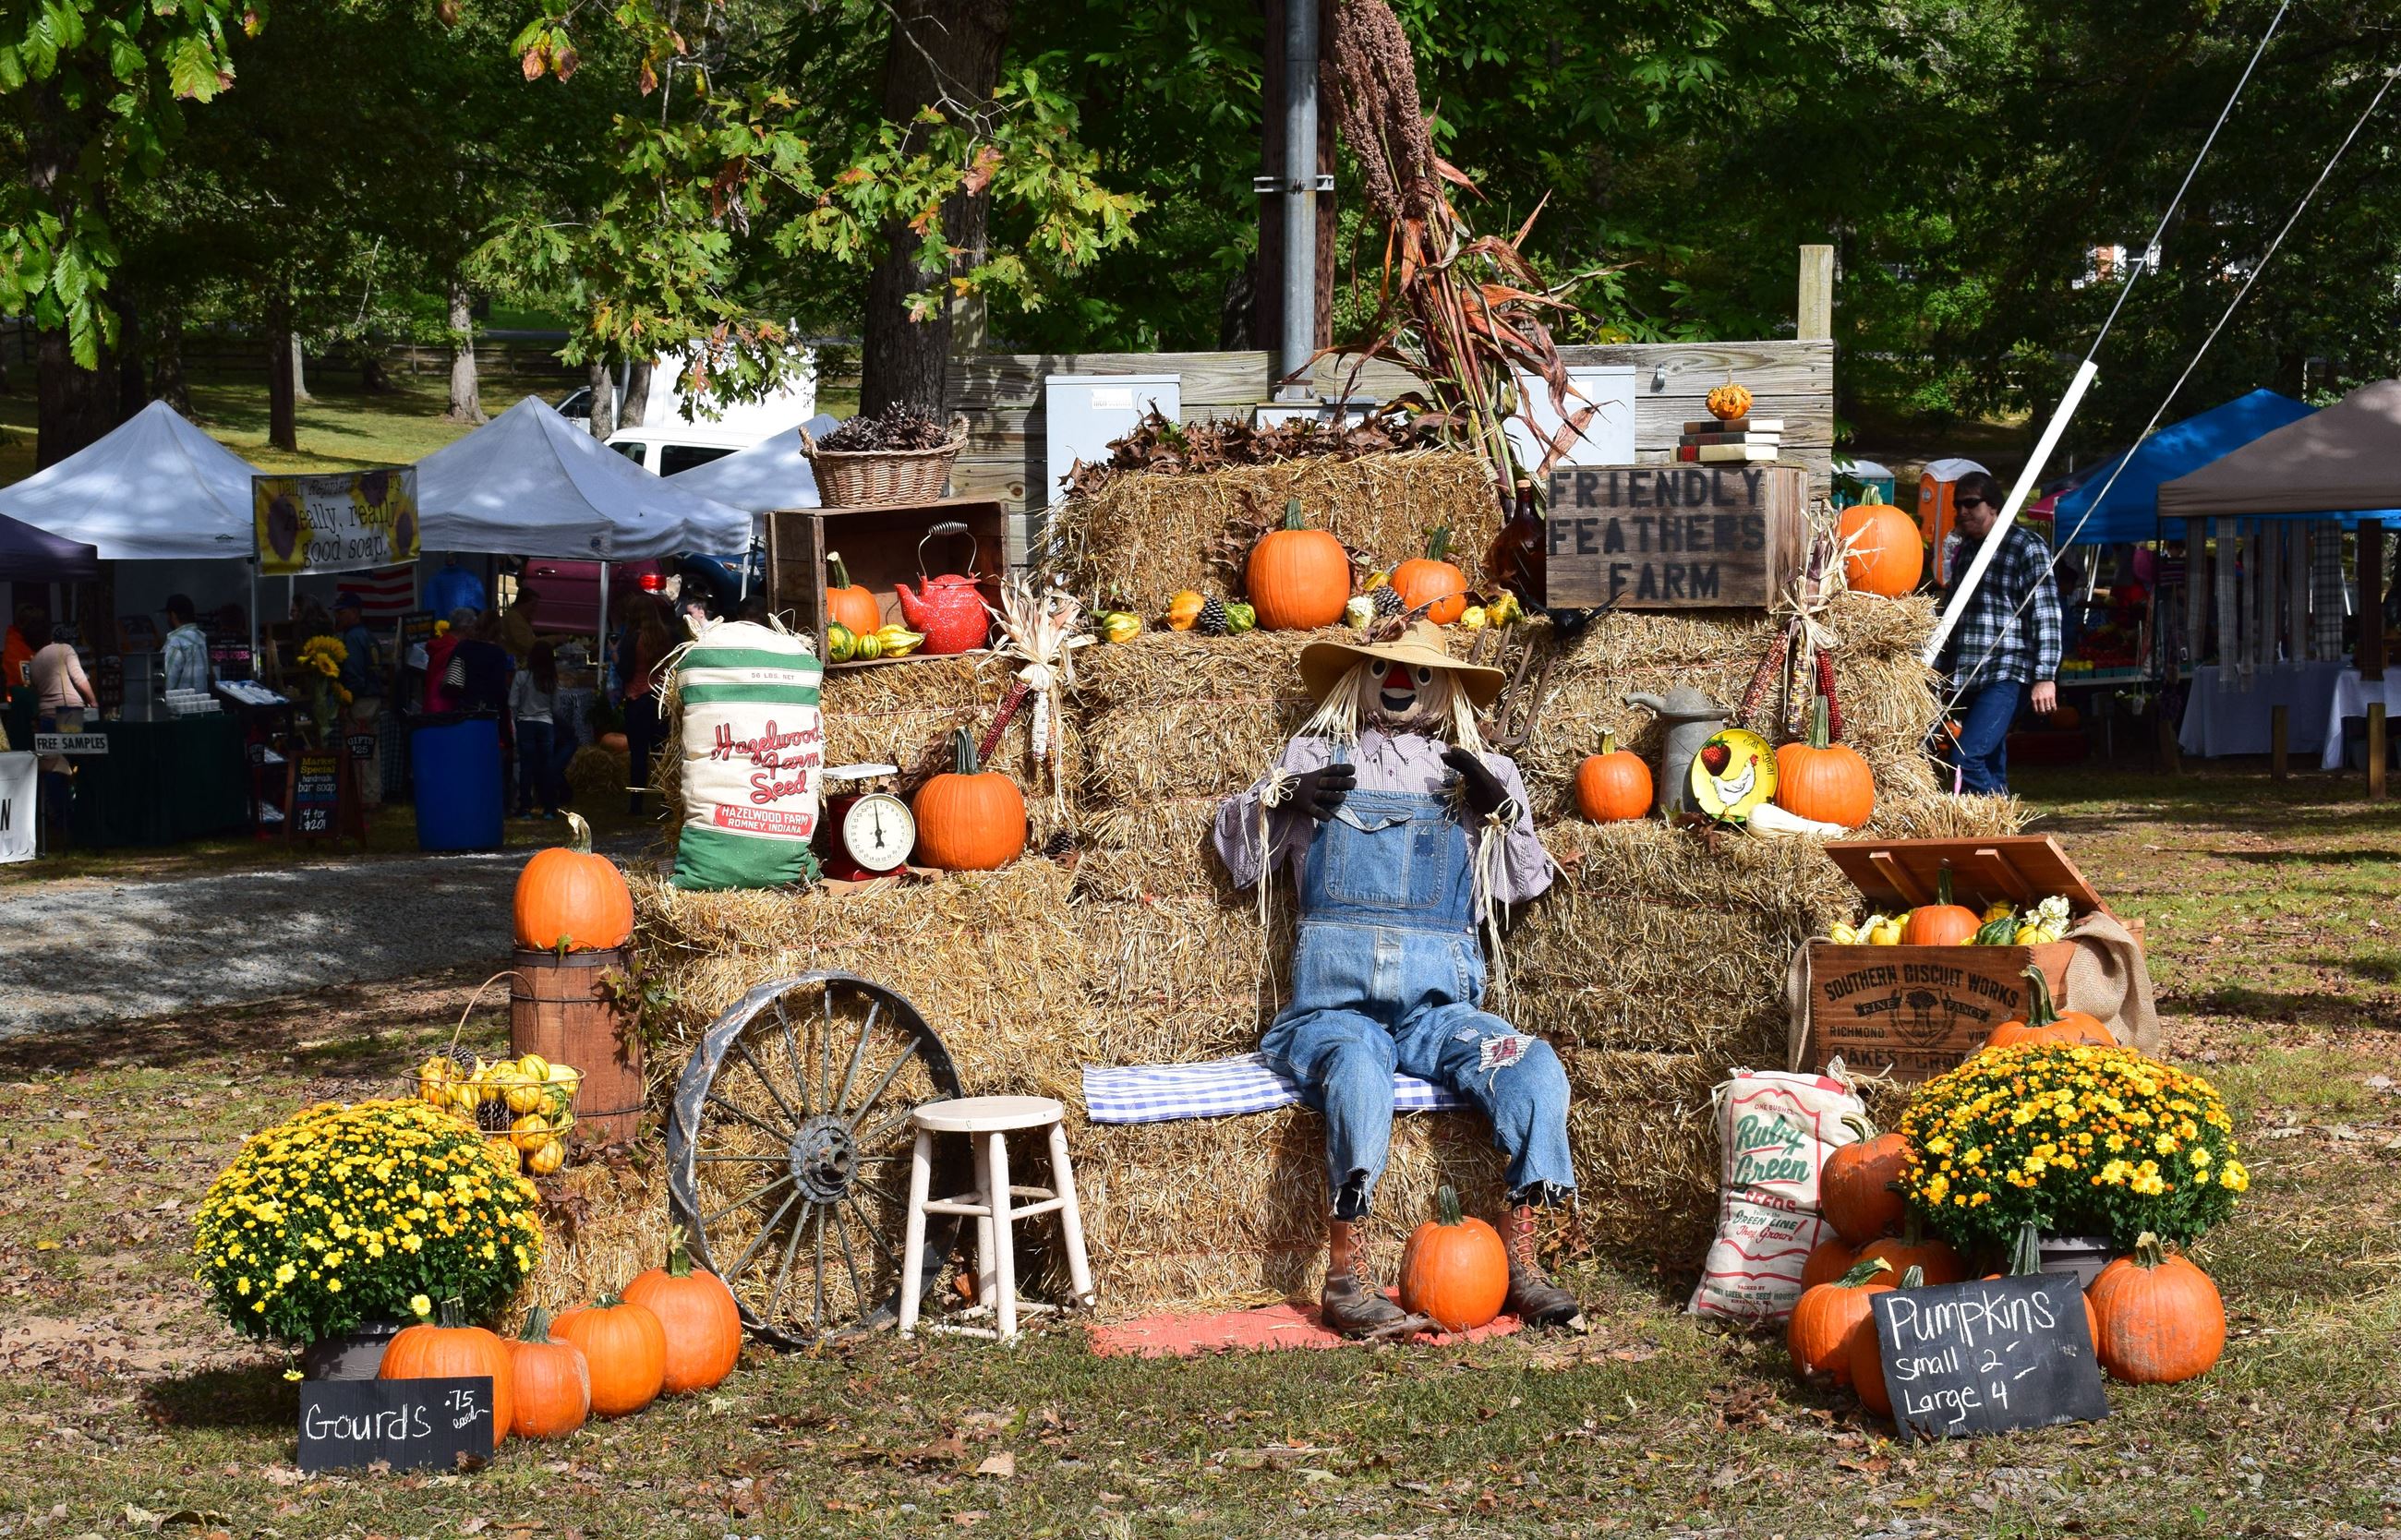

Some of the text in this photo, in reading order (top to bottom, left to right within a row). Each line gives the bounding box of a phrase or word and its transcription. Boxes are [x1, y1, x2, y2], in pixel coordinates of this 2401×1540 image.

[1549, 468, 1763, 509] FRIENDLY
[348, 498, 399, 527] really
[1549, 514, 1766, 556] FEATHERS
[302, 535, 387, 569] good soap.
[1609, 561, 1719, 600] FARM
[37, 737, 105, 749] FREE SAMPLES
[347, 736, 375, 746] GIFTS
[352, 745, 368, 754] $25
[710, 712, 820, 764] Hazelwood
[300, 765, 336, 776] Special
[302, 756, 337, 766] Market
[761, 751, 820, 779] Farm
[297, 781, 337, 794] bar soap
[750, 769, 808, 804] Seed
[303, 808, 326, 819] 4 for
[721, 806, 808, 825] HAZELWOOD FARM
[768, 822, 802, 835] INDIANA
[1824, 964, 2020, 1009] SOUTHERN BISCUIT WORKS
[1863, 1000, 1985, 1019] FINE FANCY
[1768, 1104, 1795, 1115] BUSHEL
[1735, 1113, 1805, 1157] Ruby
[1733, 1154, 1810, 1188] Green
[1744, 1190, 1796, 1214] SEEDS
[1731, 1209, 1768, 1225] GREEN
[1736, 1225, 1757, 1241] They
[1756, 1292, 1772, 1300] SEED
[1773, 1293, 1796, 1301] HOUSE
[1886, 1290, 2056, 1350] Pumpkins
[444, 1389, 476, 1412] .75
[1903, 1386, 1982, 1426] Large
[306, 1402, 432, 1440] Gourds
